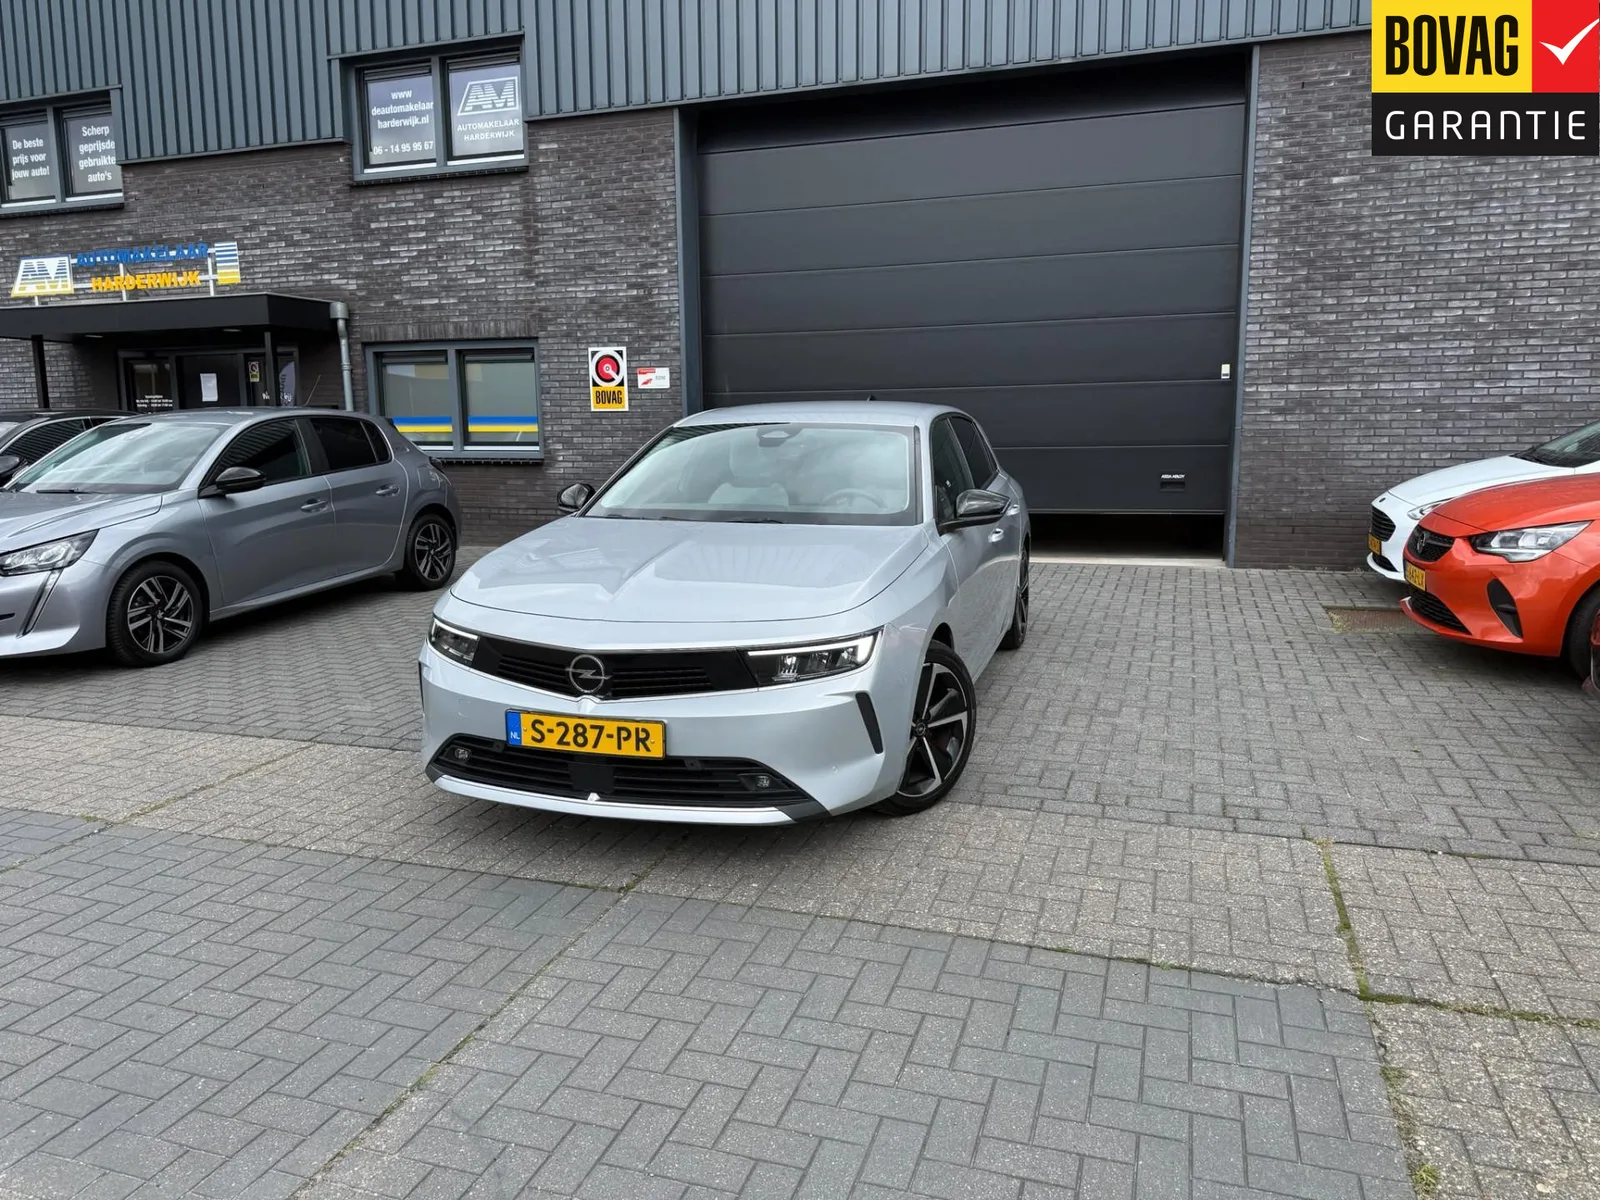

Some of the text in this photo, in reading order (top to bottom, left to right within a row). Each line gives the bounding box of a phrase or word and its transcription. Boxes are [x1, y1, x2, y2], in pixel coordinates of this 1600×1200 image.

[391, 89, 412, 100] www
[371, 101, 434, 116] deautomakelaar
[377, 116, 429, 129] harderwijk.nl
[457, 118, 520, 132] AUTOMAKELAAR
[82, 125, 110, 137] Scherp
[464, 130, 515, 141] HARDERWIJK
[12, 138, 44, 150] De beste
[79, 139, 116, 154] geprijsde
[373, 145, 383, 155] 06
[390, 144, 400, 154] 14
[401, 143, 411, 153] 95
[412, 142, 422, 151] 95
[424, 141, 434, 150] 67
[12, 153, 47, 166] prijs voor
[79, 155, 116, 170] gebruikte
[11, 166, 50, 180] jouw auto!
[87, 171, 113, 183] auto's
[76, 243, 209, 268] AUTOMAKELAAR
[91, 270, 201, 292] HARDERWIJK
[595, 390, 623, 404] BOVAG
[510, 719, 652, 752] NL S-287-PR
